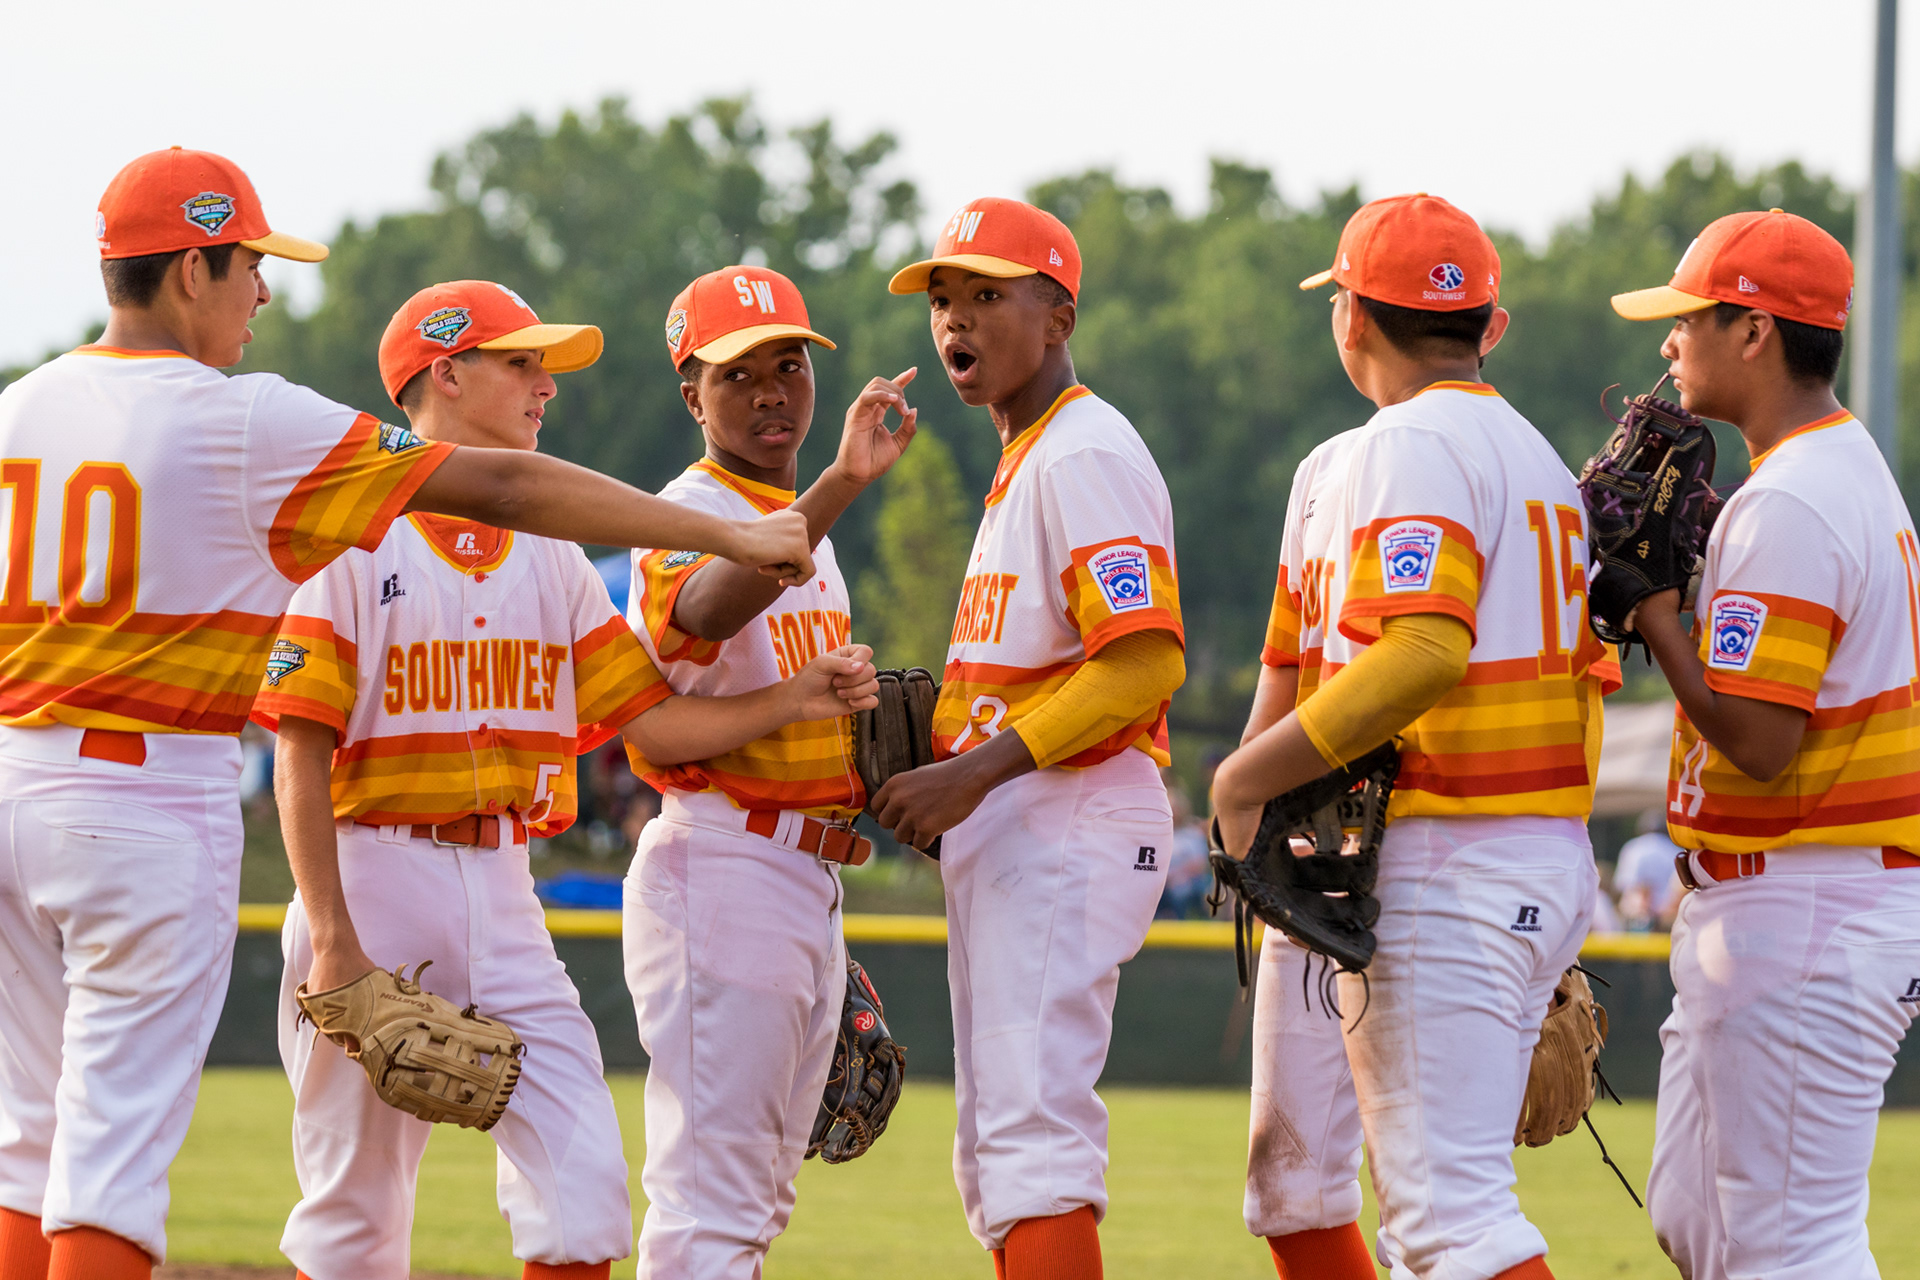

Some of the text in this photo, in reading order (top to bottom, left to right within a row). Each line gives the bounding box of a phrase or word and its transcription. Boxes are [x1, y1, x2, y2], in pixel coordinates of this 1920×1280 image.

[947, 207, 985, 243] SW
[733, 275, 777, 314] SW
[1422, 290, 1467, 300] SOUTHWEST
[1654, 465, 1682, 516] RICKY
[0, 458, 142, 632] 10
[1409, 526, 1436, 538] LEAGUE
[1094, 550, 1143, 568] JUNIOR LEAGUE
[1525, 500, 1590, 682] 15
[1738, 602, 1762, 615] LEAGUE
[384, 638, 569, 716] SOUTHWEST
[519, 761, 563, 825] 5
[380, 992, 429, 1009] EASTON
